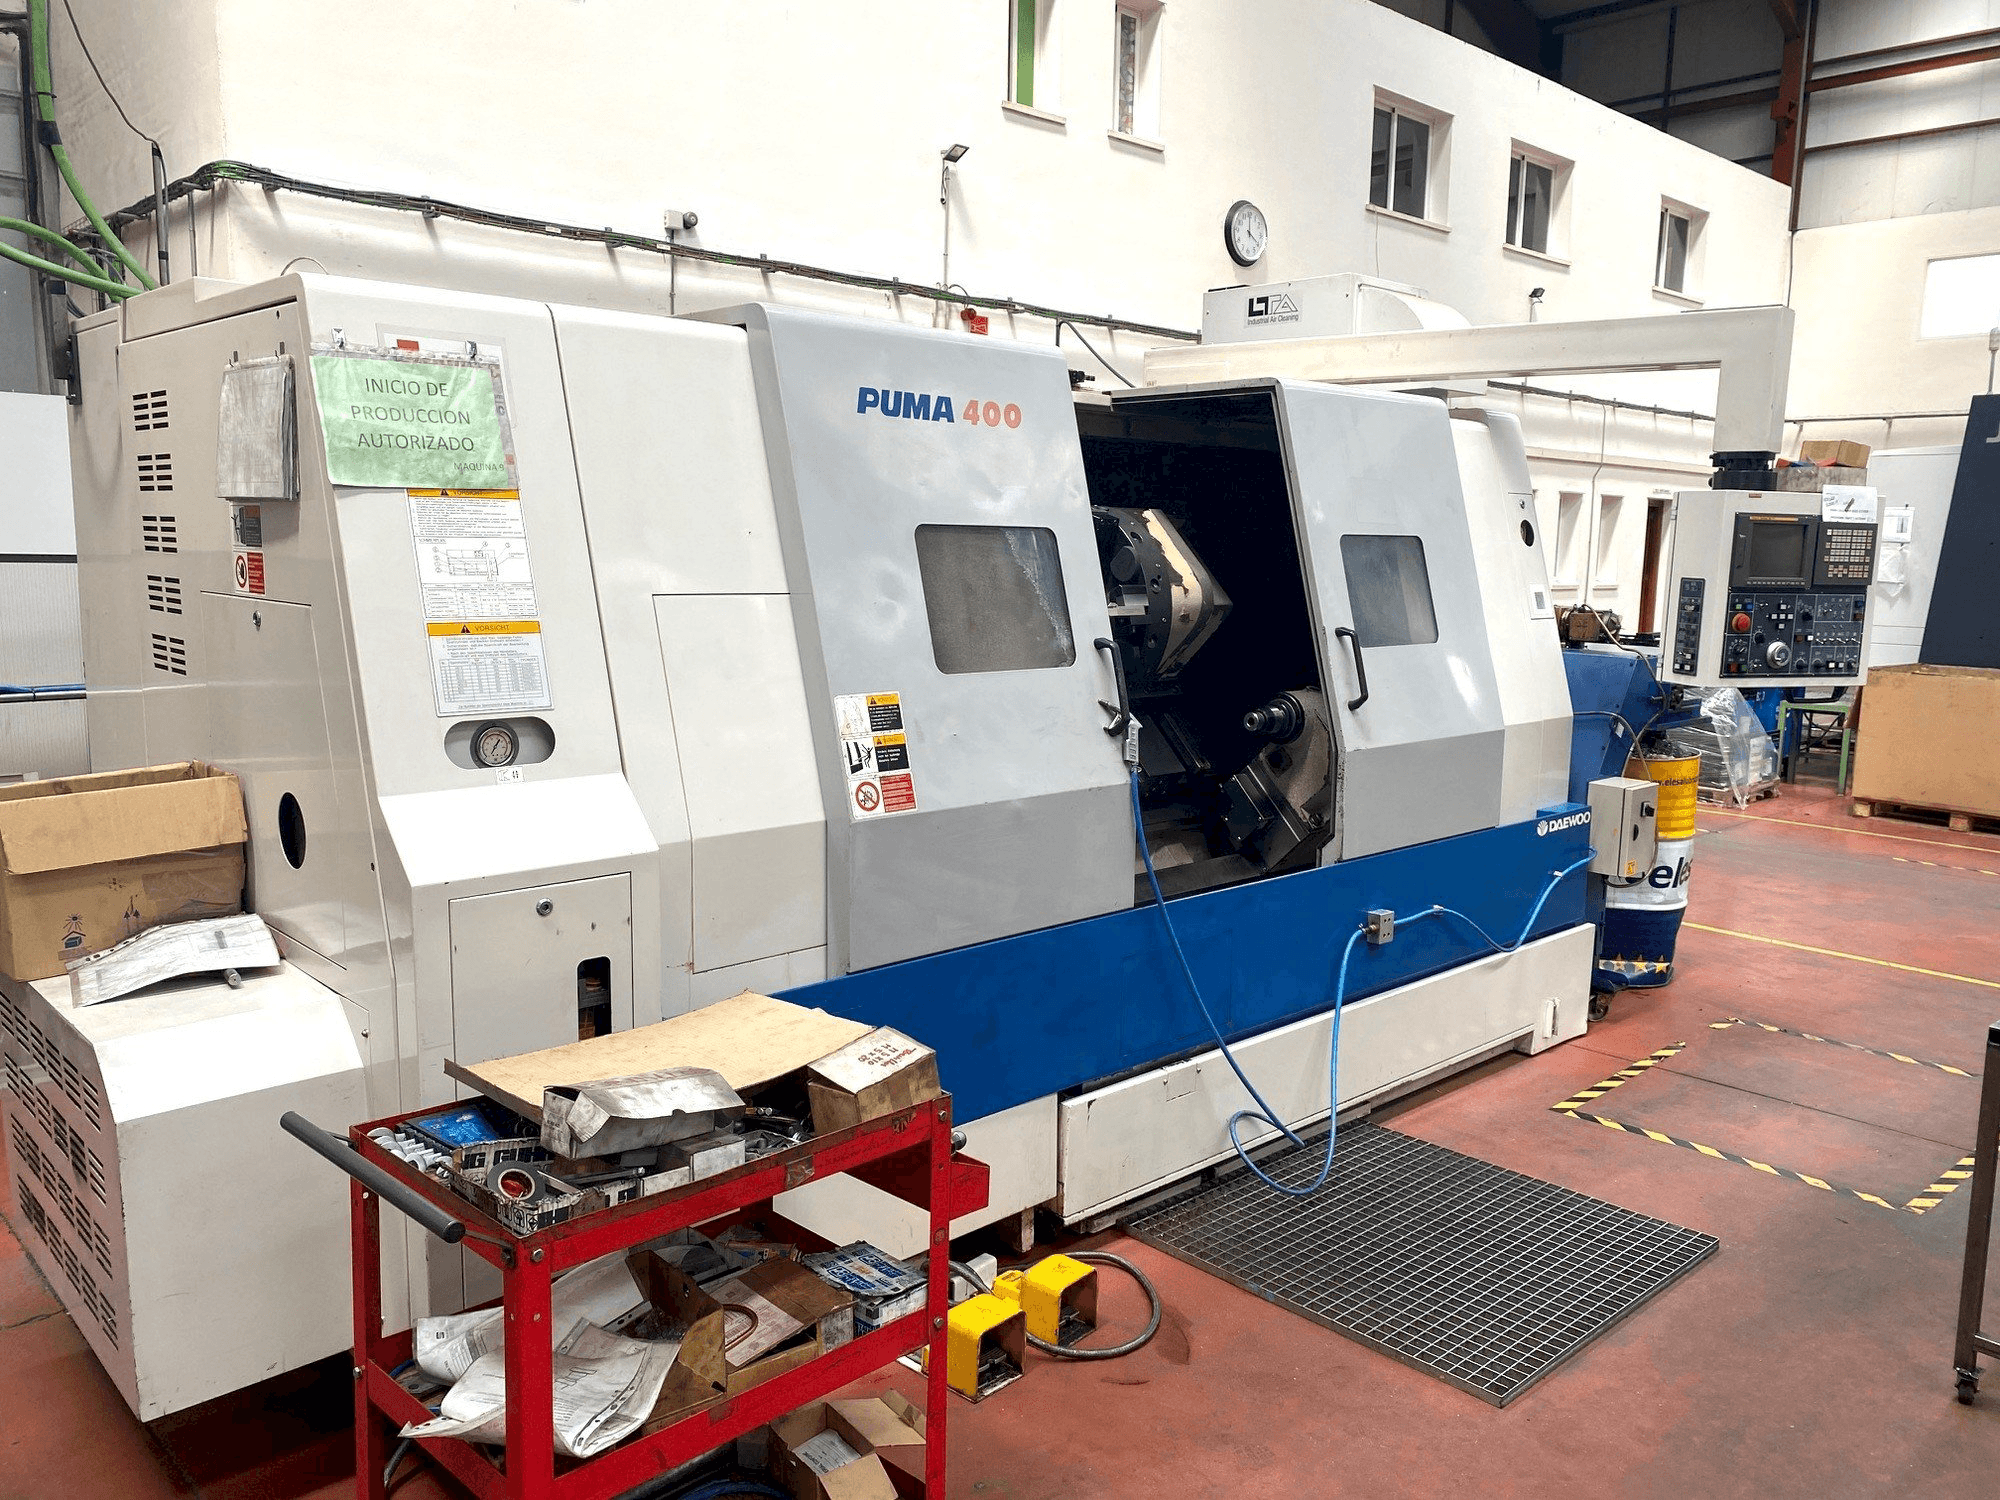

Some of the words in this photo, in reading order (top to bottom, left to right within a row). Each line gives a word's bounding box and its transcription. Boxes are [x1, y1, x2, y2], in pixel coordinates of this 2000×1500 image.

[1247, 316, 1269, 325] Industrial
[1278, 314, 1299, 322] Cleaning
[365, 378, 421, 396] INICIO
[426, 382, 449, 397] DE
[351, 405, 471, 425] PRODUCCION
[856, 386, 955, 423] PUMA
[962, 399, 1022, 429] 400
[358, 433, 475, 452] AUTORIZADO
[453, 462, 498, 471] MAQUINA
[1549, 811, 1591, 833] DAEWOO
